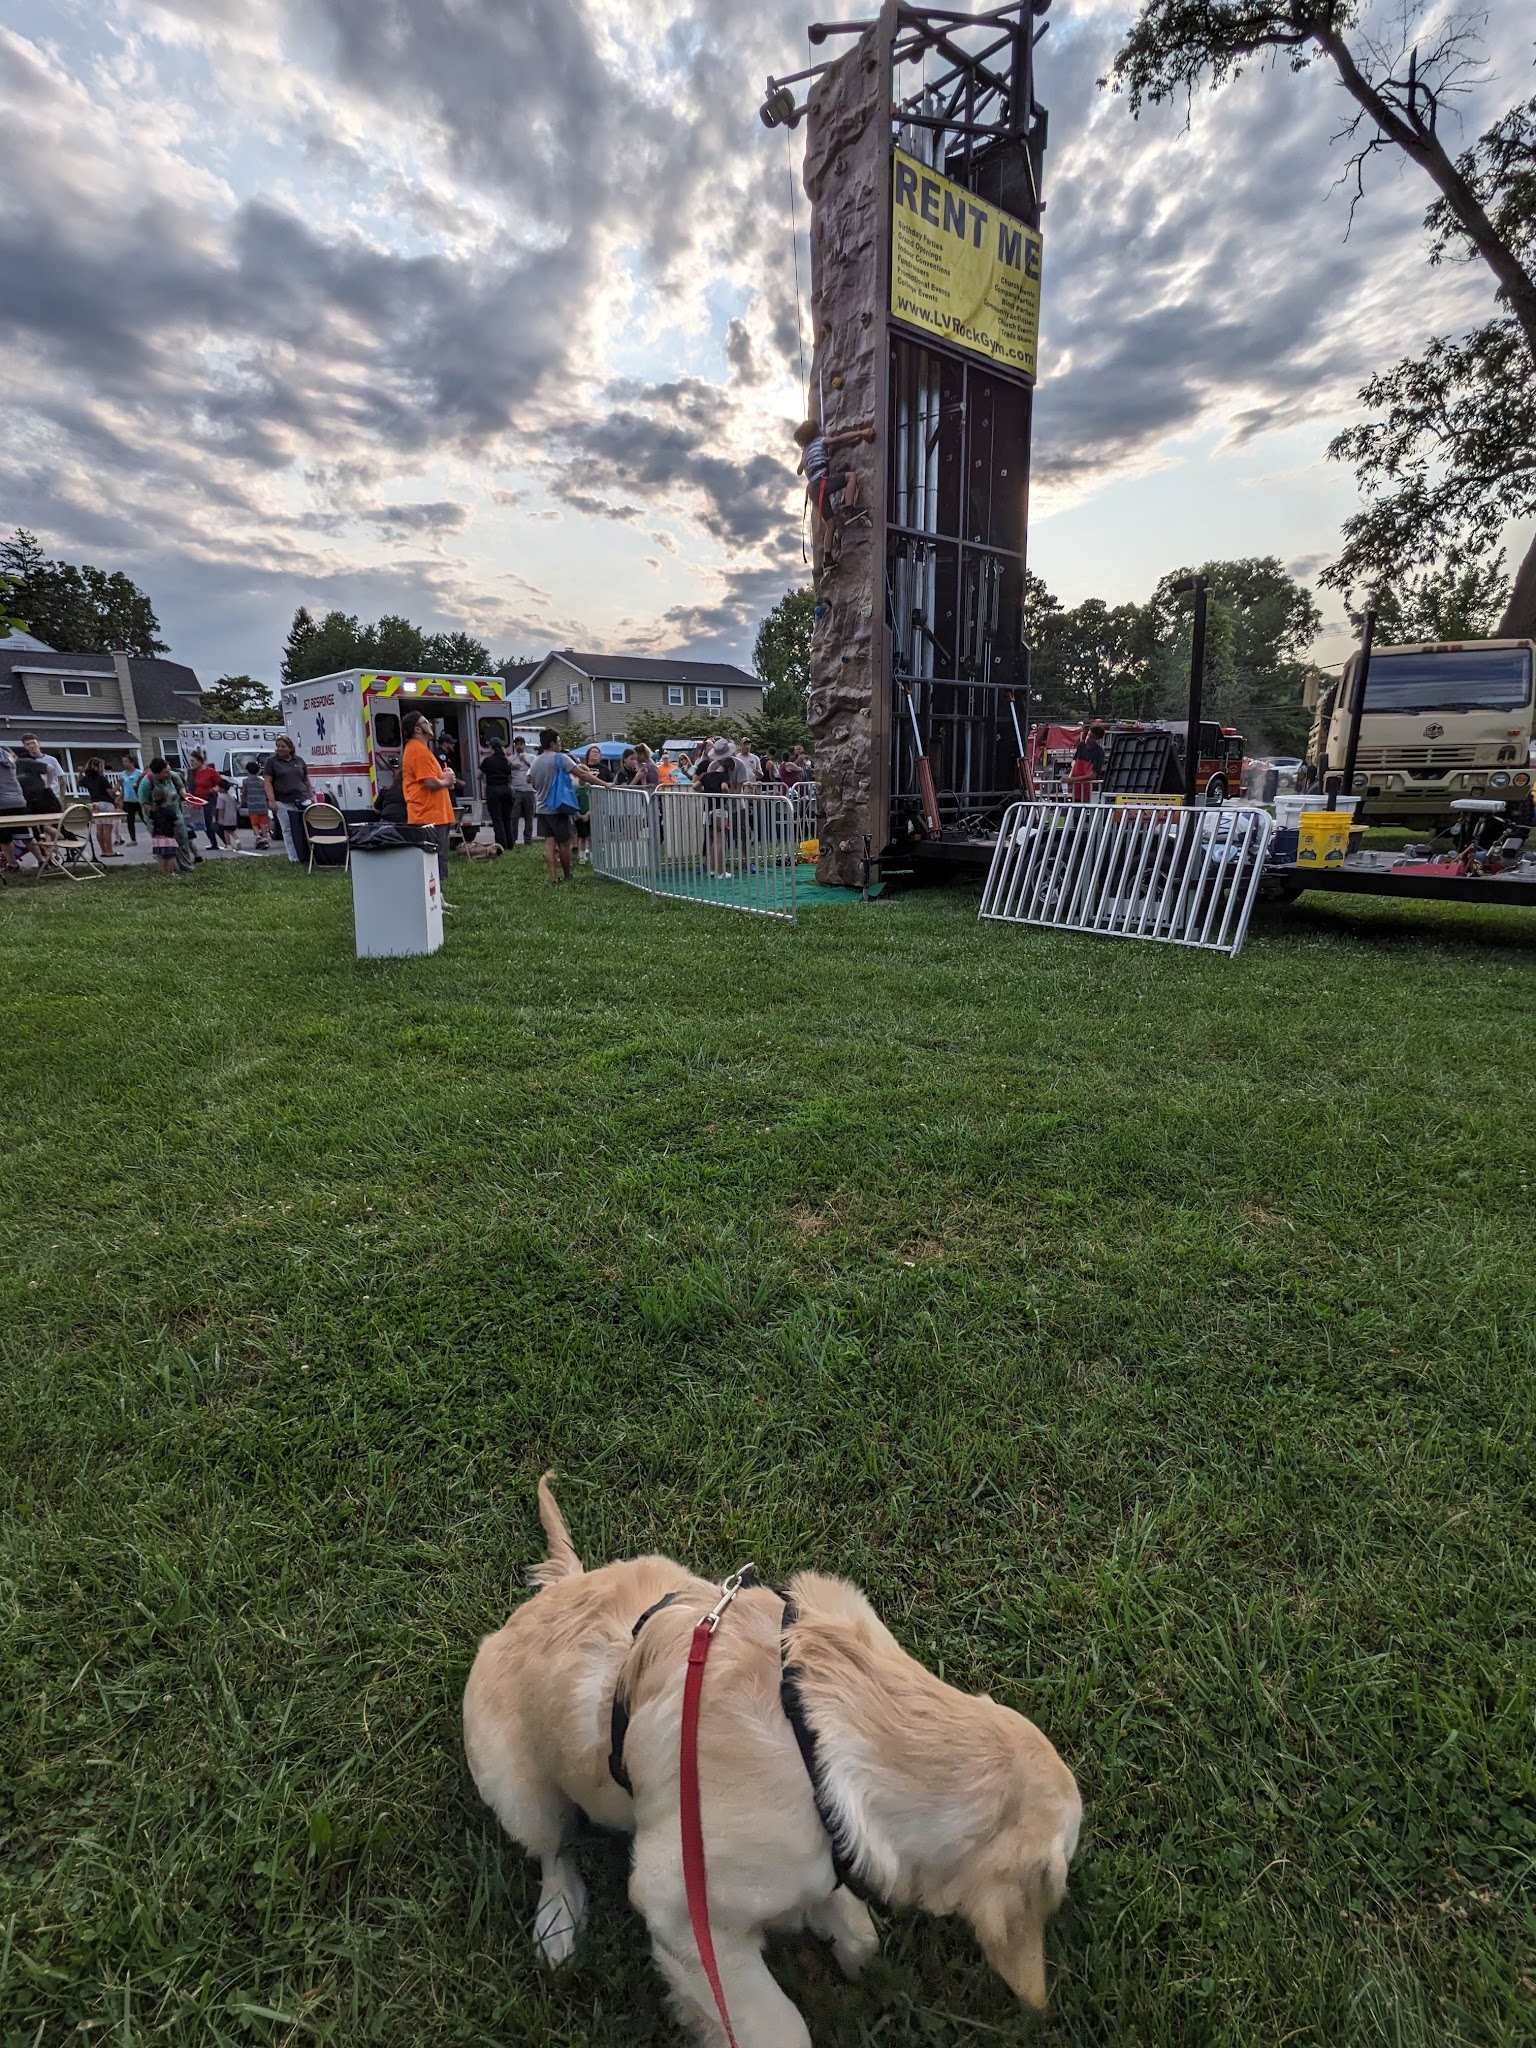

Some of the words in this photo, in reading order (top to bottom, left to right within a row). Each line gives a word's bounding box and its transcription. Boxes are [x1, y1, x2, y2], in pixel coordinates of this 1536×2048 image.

[895, 160, 988, 249] RENT
[997, 221, 1041, 281] ME
[897, 231, 914, 248] Grand
[915, 242, 942, 262] Openings
[898, 219, 922, 241] Birthday
[923, 233, 943, 251] Parties
[897, 242, 914, 259] Indoor
[915, 254, 951, 277] Conventions
[897, 254, 929, 278] Fundraisers
[897, 265, 930, 288] Promotional
[930, 283, 951, 298] Events
[897, 277, 917, 294] College
[918, 288, 938, 303] Events
[994, 284, 1017, 302] Company
[1001, 276, 1019, 291] Church
[310, 693, 335, 709] RESPONSE
[311, 744, 337, 757] AMBULANCE
